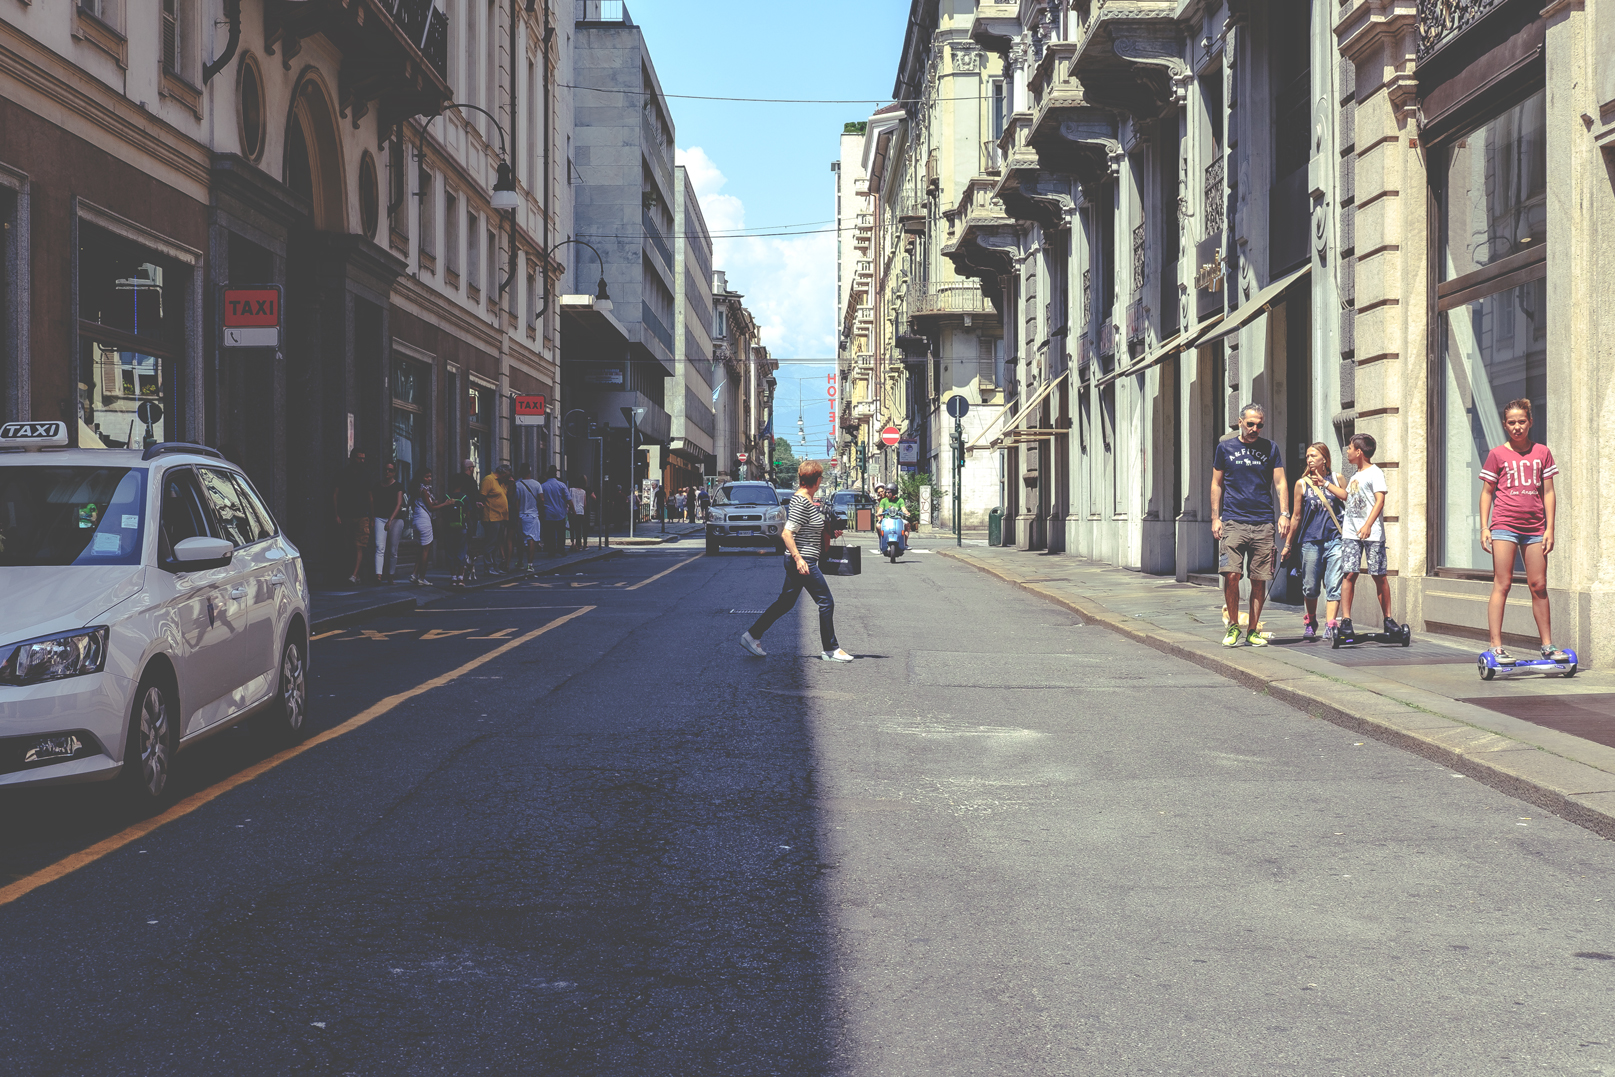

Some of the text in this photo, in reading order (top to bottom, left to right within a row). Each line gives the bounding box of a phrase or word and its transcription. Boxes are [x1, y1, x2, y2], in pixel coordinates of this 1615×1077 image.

[229, 300, 274, 316] TAXI
[518, 401, 543, 410] TAXI
[6, 424, 56, 437] TAXI
[309, 628, 520, 641] TAXI
